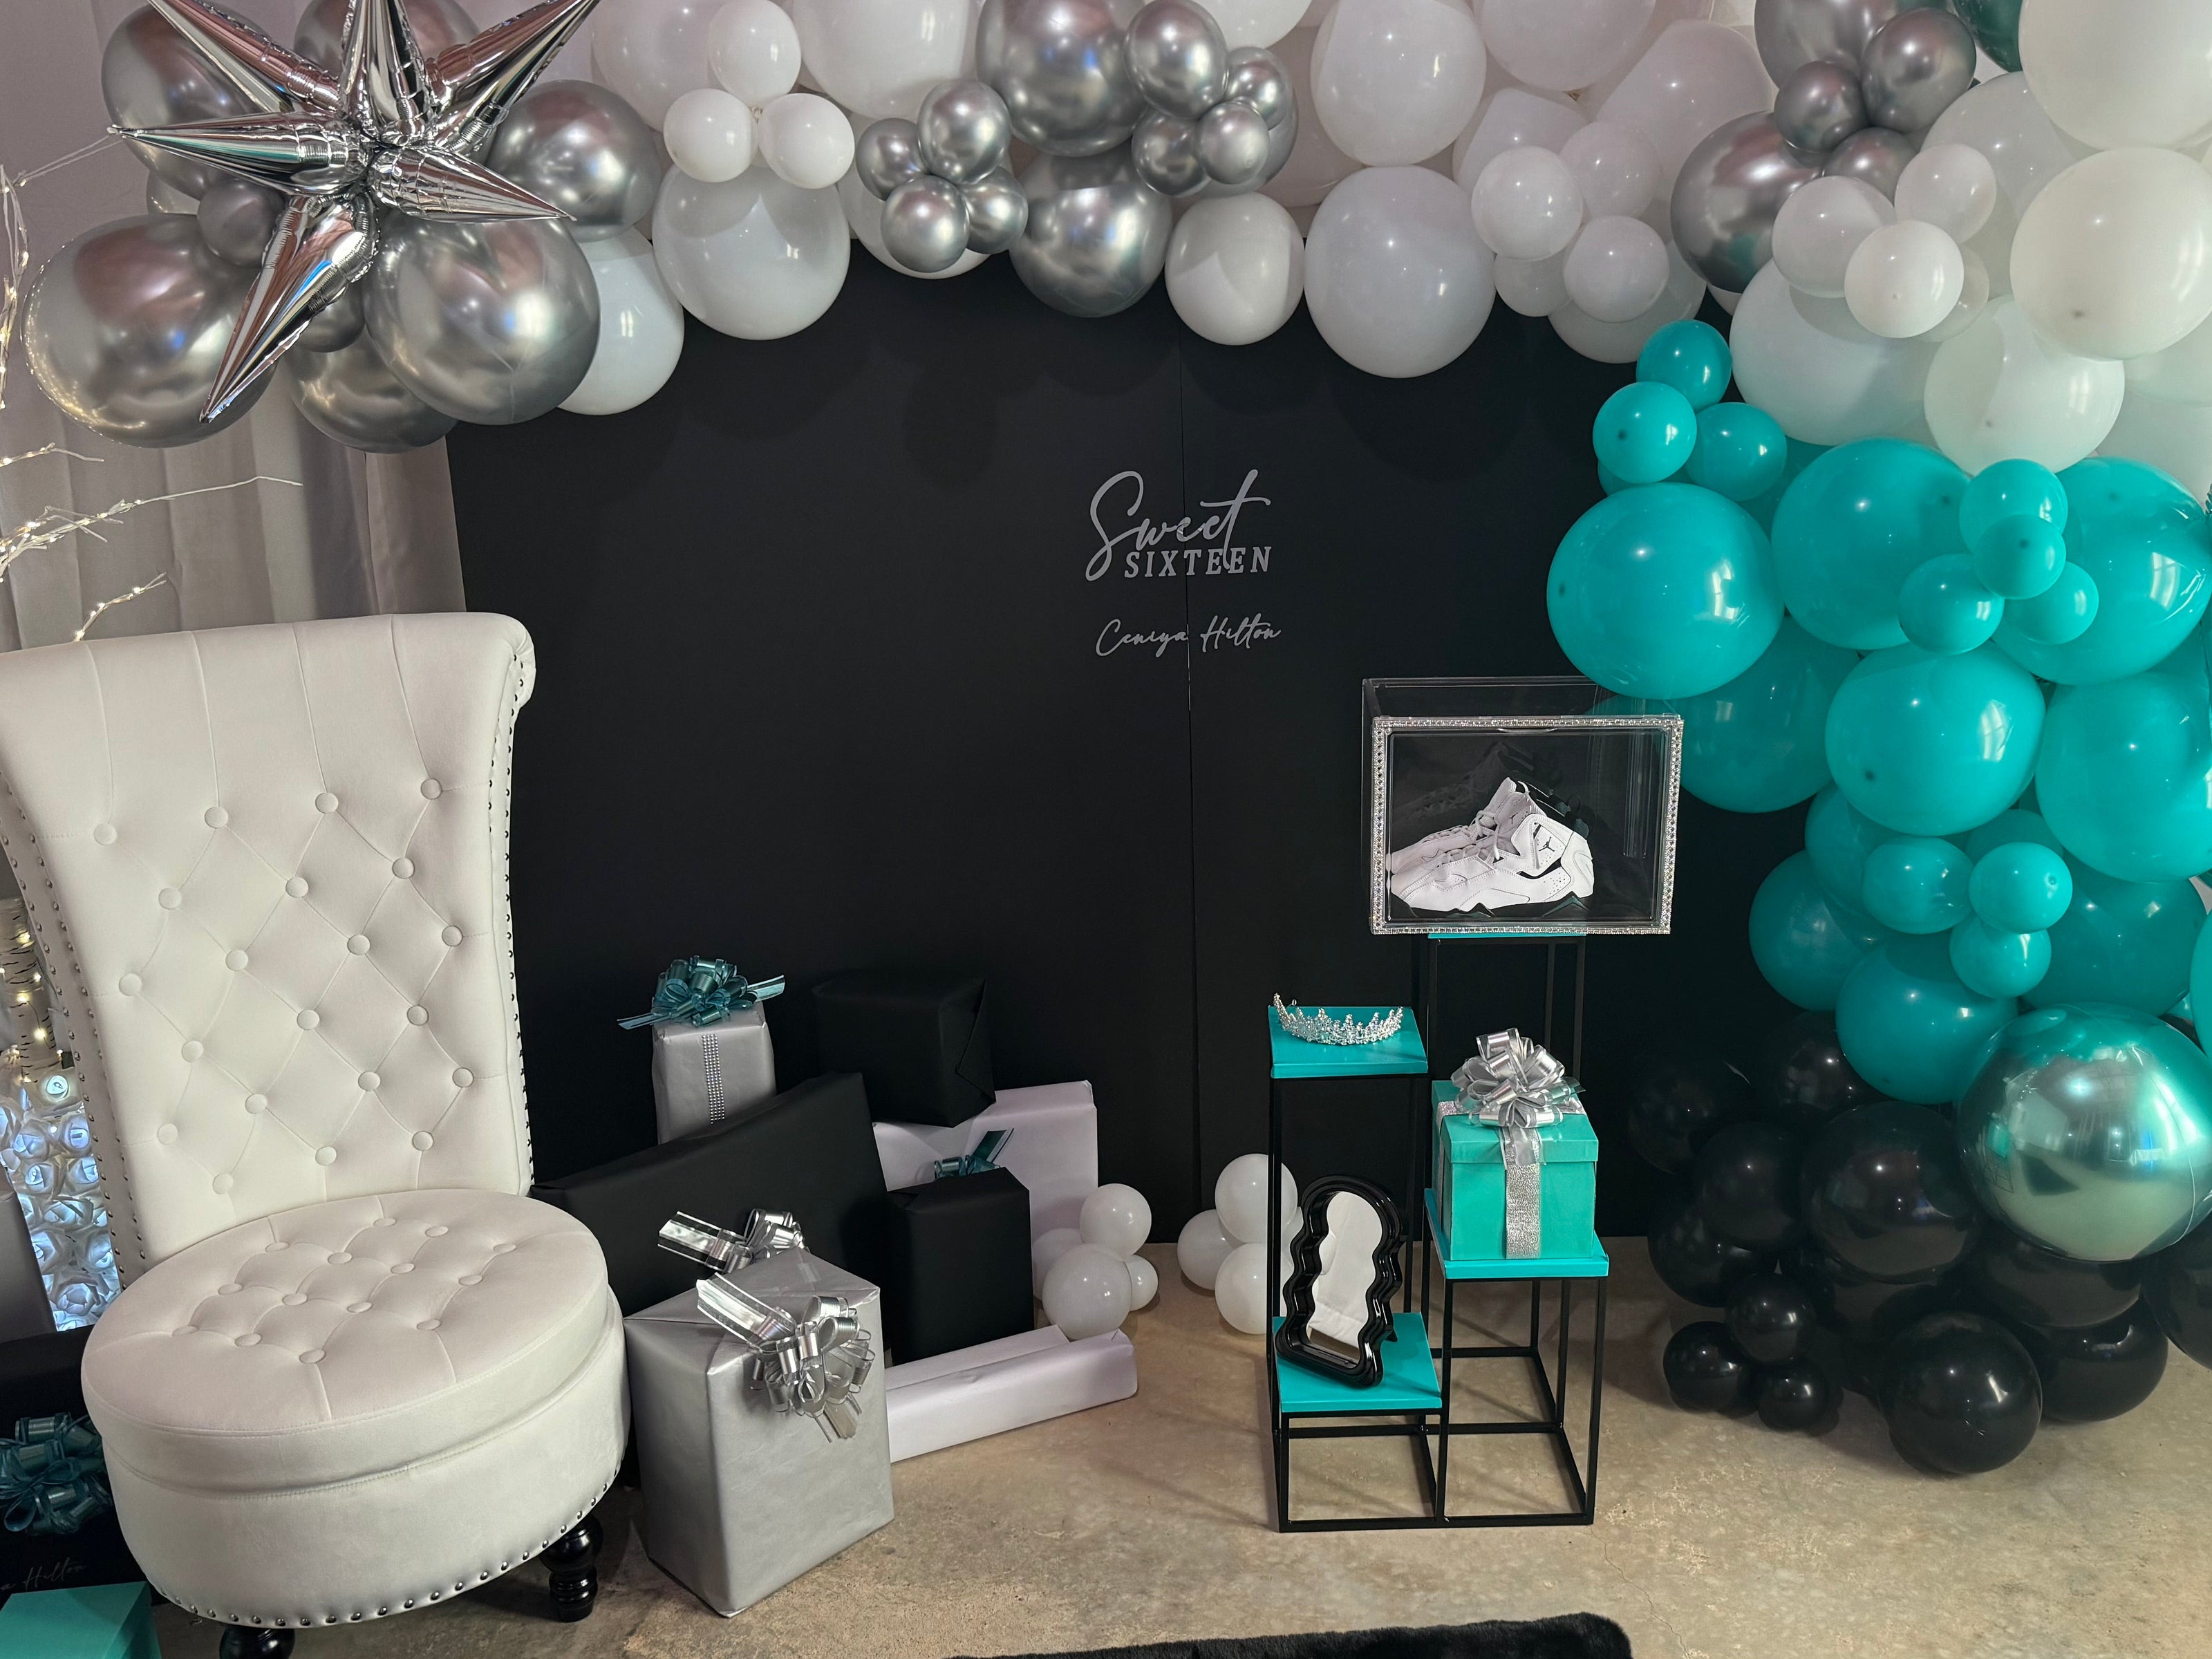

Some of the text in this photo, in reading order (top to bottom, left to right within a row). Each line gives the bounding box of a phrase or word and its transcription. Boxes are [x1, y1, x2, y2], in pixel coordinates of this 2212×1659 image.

[1085, 469, 1271, 581] Sweet
[1124, 546, 1272, 578] SIXTEEN
[1200, 613, 1281, 653] Hilton
